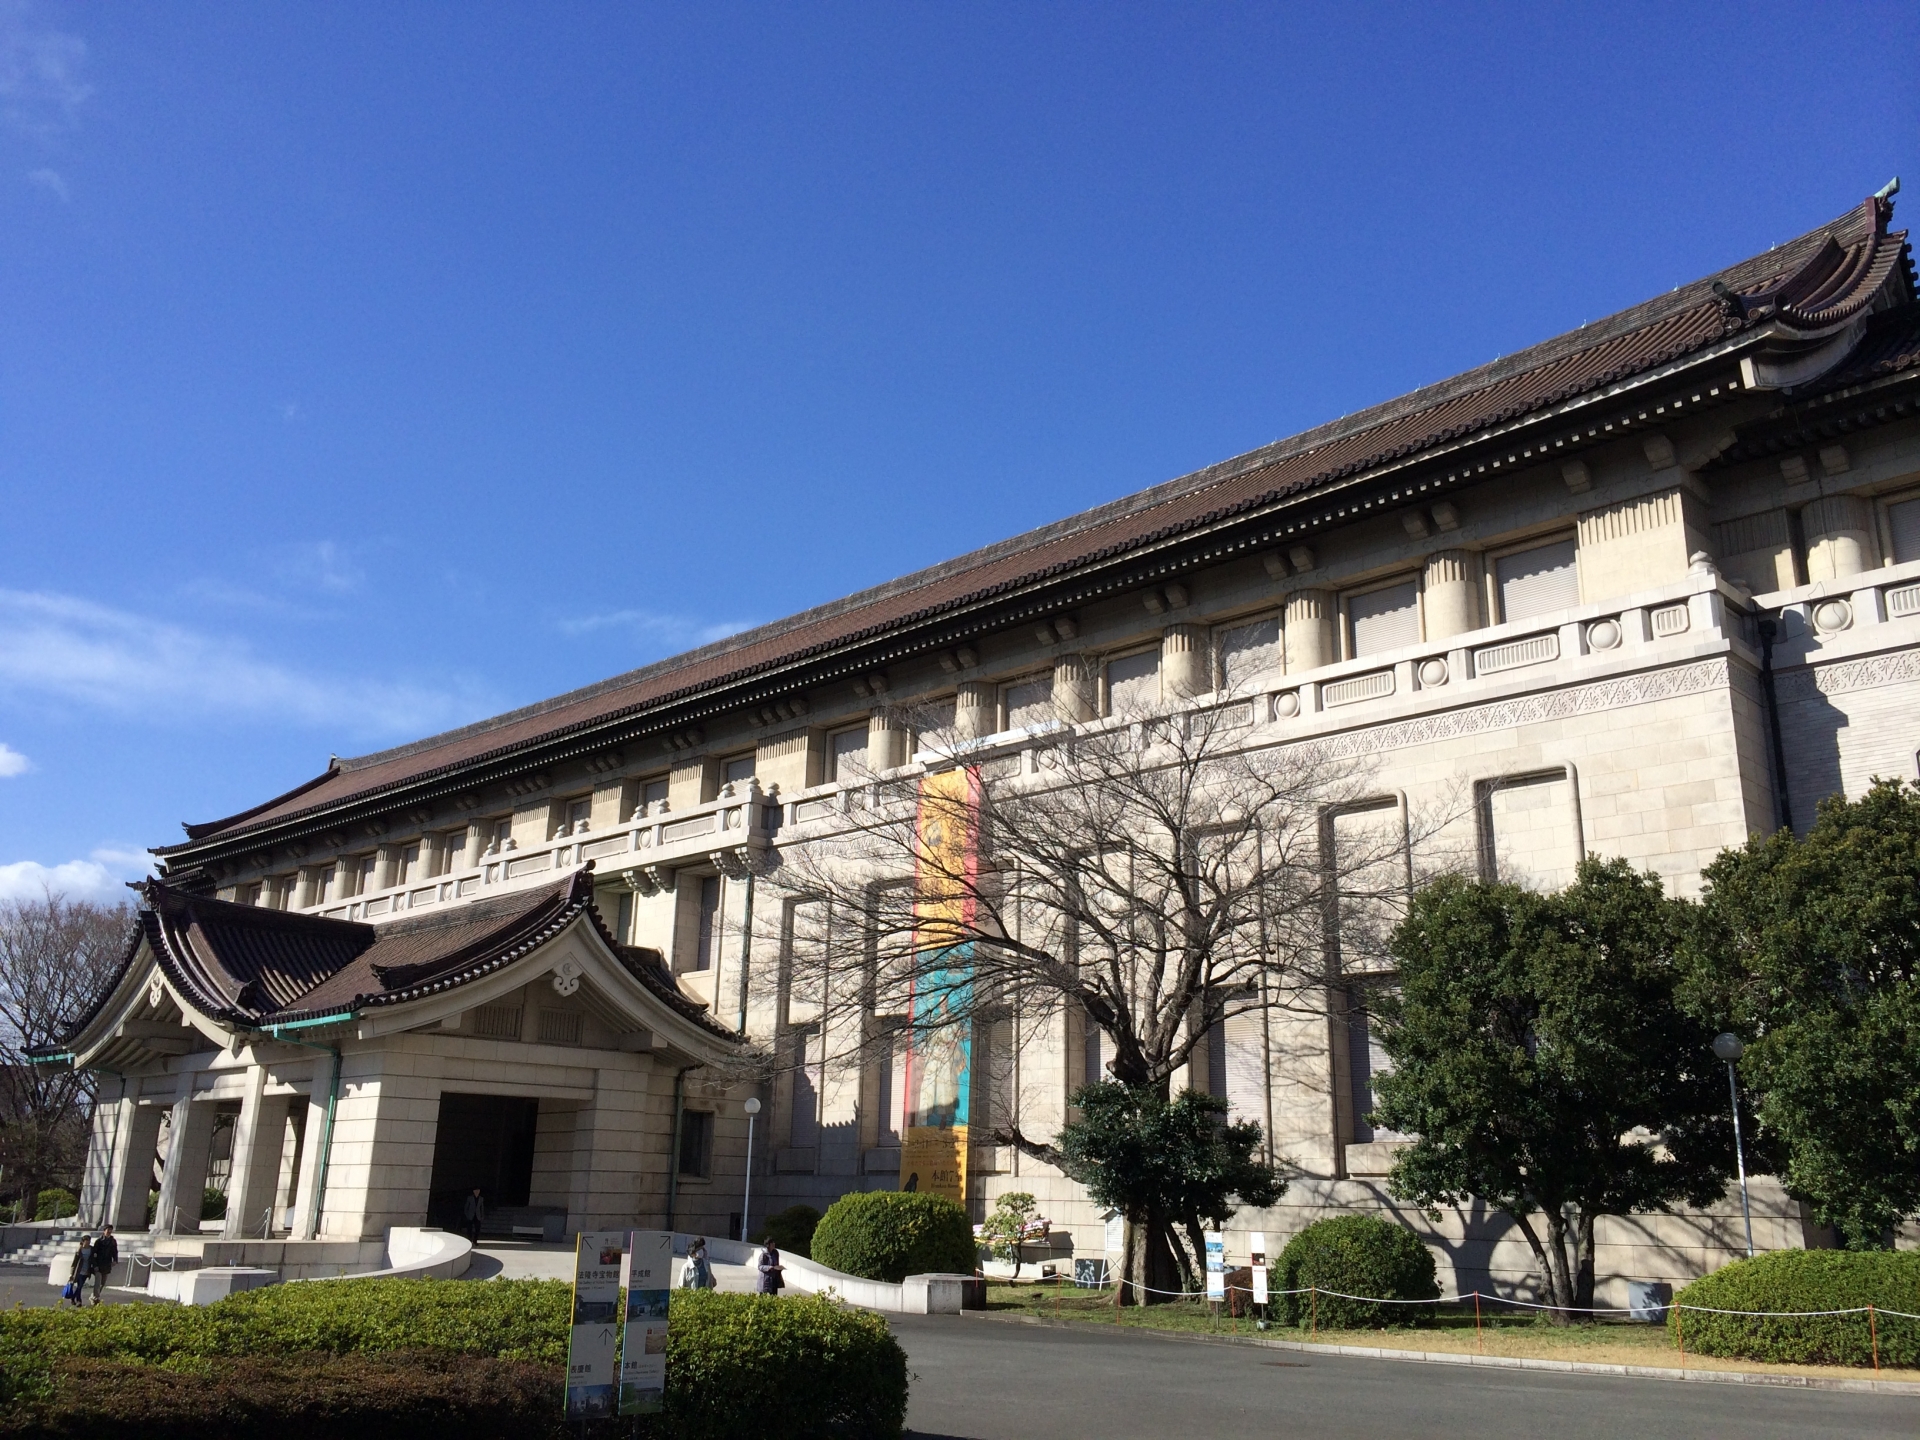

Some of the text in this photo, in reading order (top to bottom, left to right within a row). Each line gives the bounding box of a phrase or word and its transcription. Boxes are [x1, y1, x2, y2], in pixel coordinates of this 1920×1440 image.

[578, 1270, 620, 1279] 法隆寺宝物館
[631, 1269, 651, 1278] 平成館
[570, 1364, 591, 1373] 表慶館
[624, 1361, 638, 1369] 本館
